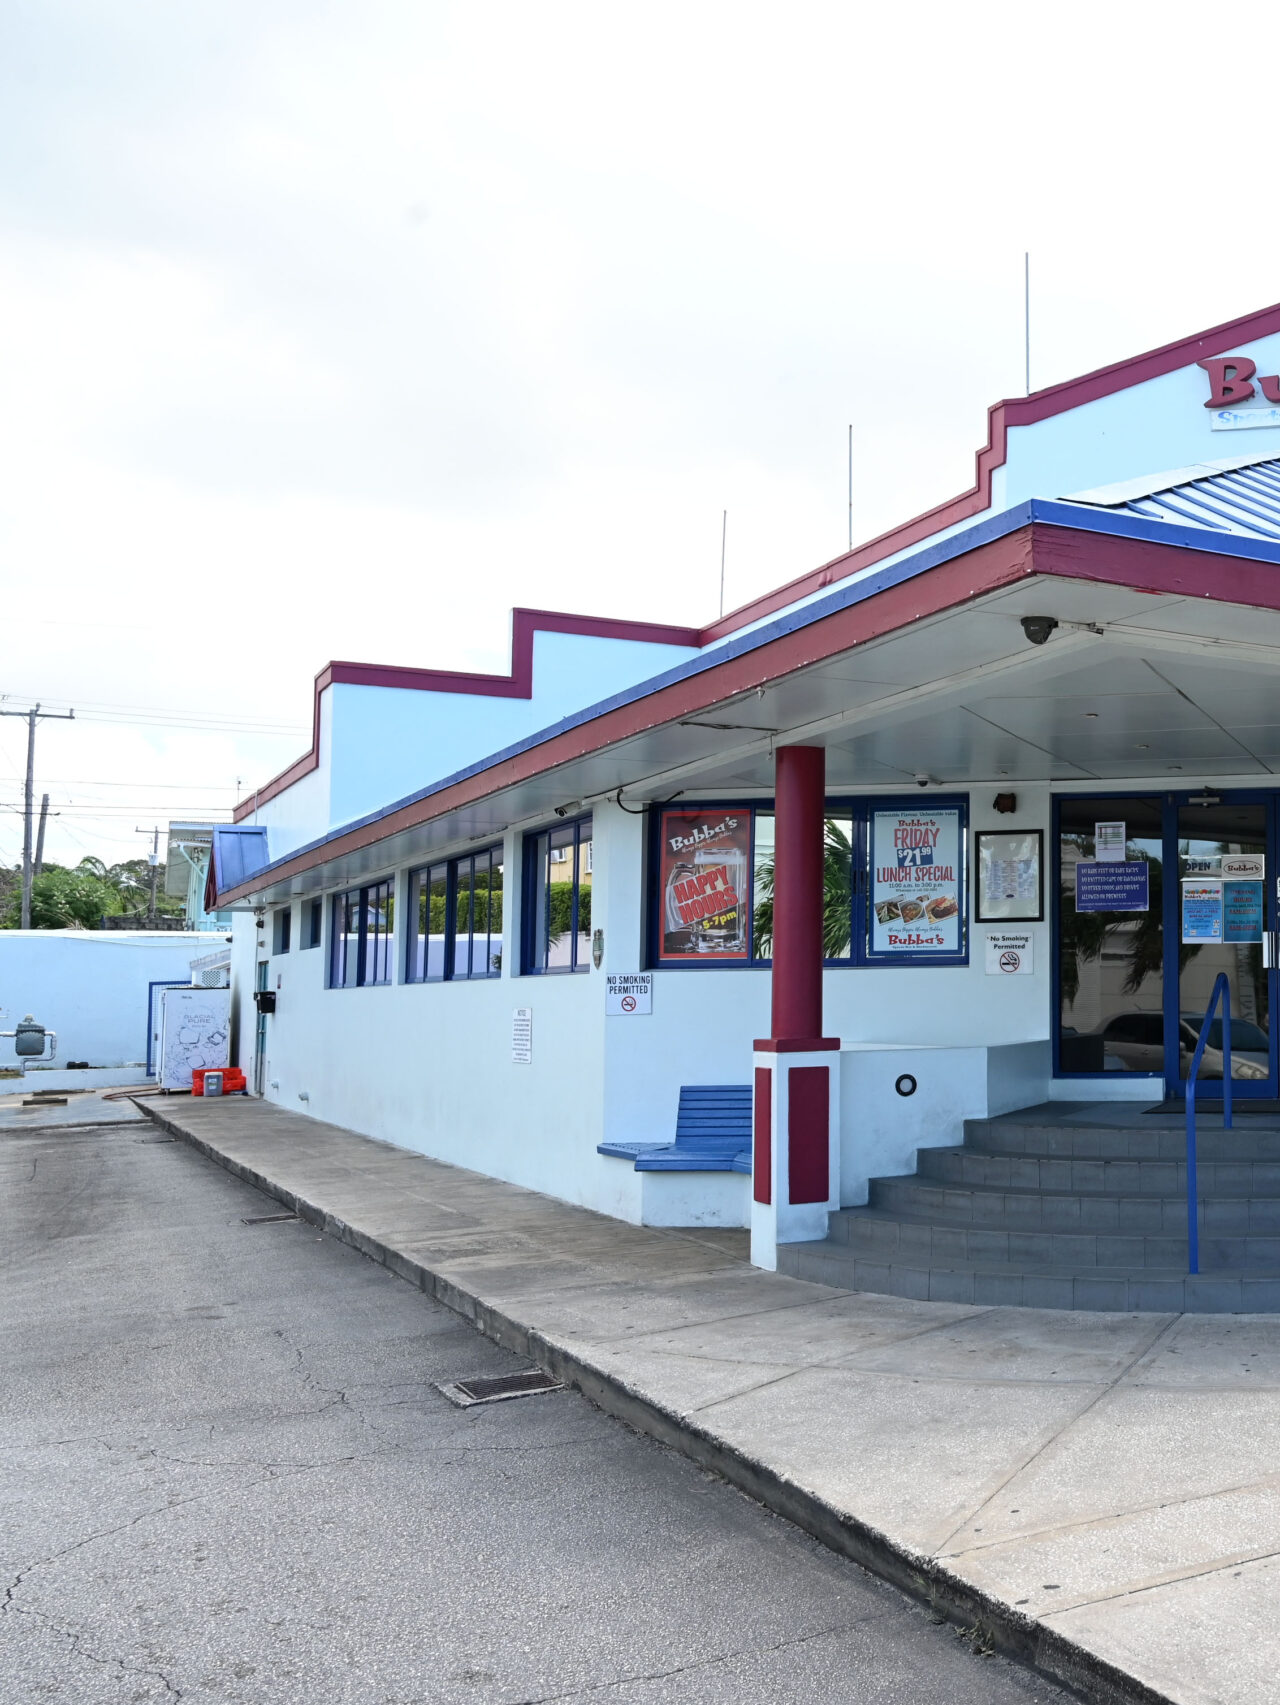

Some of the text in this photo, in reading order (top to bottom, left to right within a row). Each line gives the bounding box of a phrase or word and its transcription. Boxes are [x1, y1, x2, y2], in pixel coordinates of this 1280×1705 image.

[897, 819, 936, 827] Bubba's
[669, 816, 738, 852] Bubba's
[894, 827, 940, 848] FRIDAY
[898, 847, 931, 867] $21.99
[1185, 862, 1211, 871] OPEN
[1227, 863, 1260, 872] Bubba's
[877, 865, 956, 883] LUNCH SPECIAL
[673, 864, 729, 904] HAPPY
[678, 885, 738, 925] HOURS
[702, 911, 737, 929] 5-7pm
[888, 934, 945, 945] Bubba's
[1001, 935, 1029, 943] Smoking
[607, 975, 651, 985] NO SMOKING
[609, 985, 649, 995] PERMITTED
